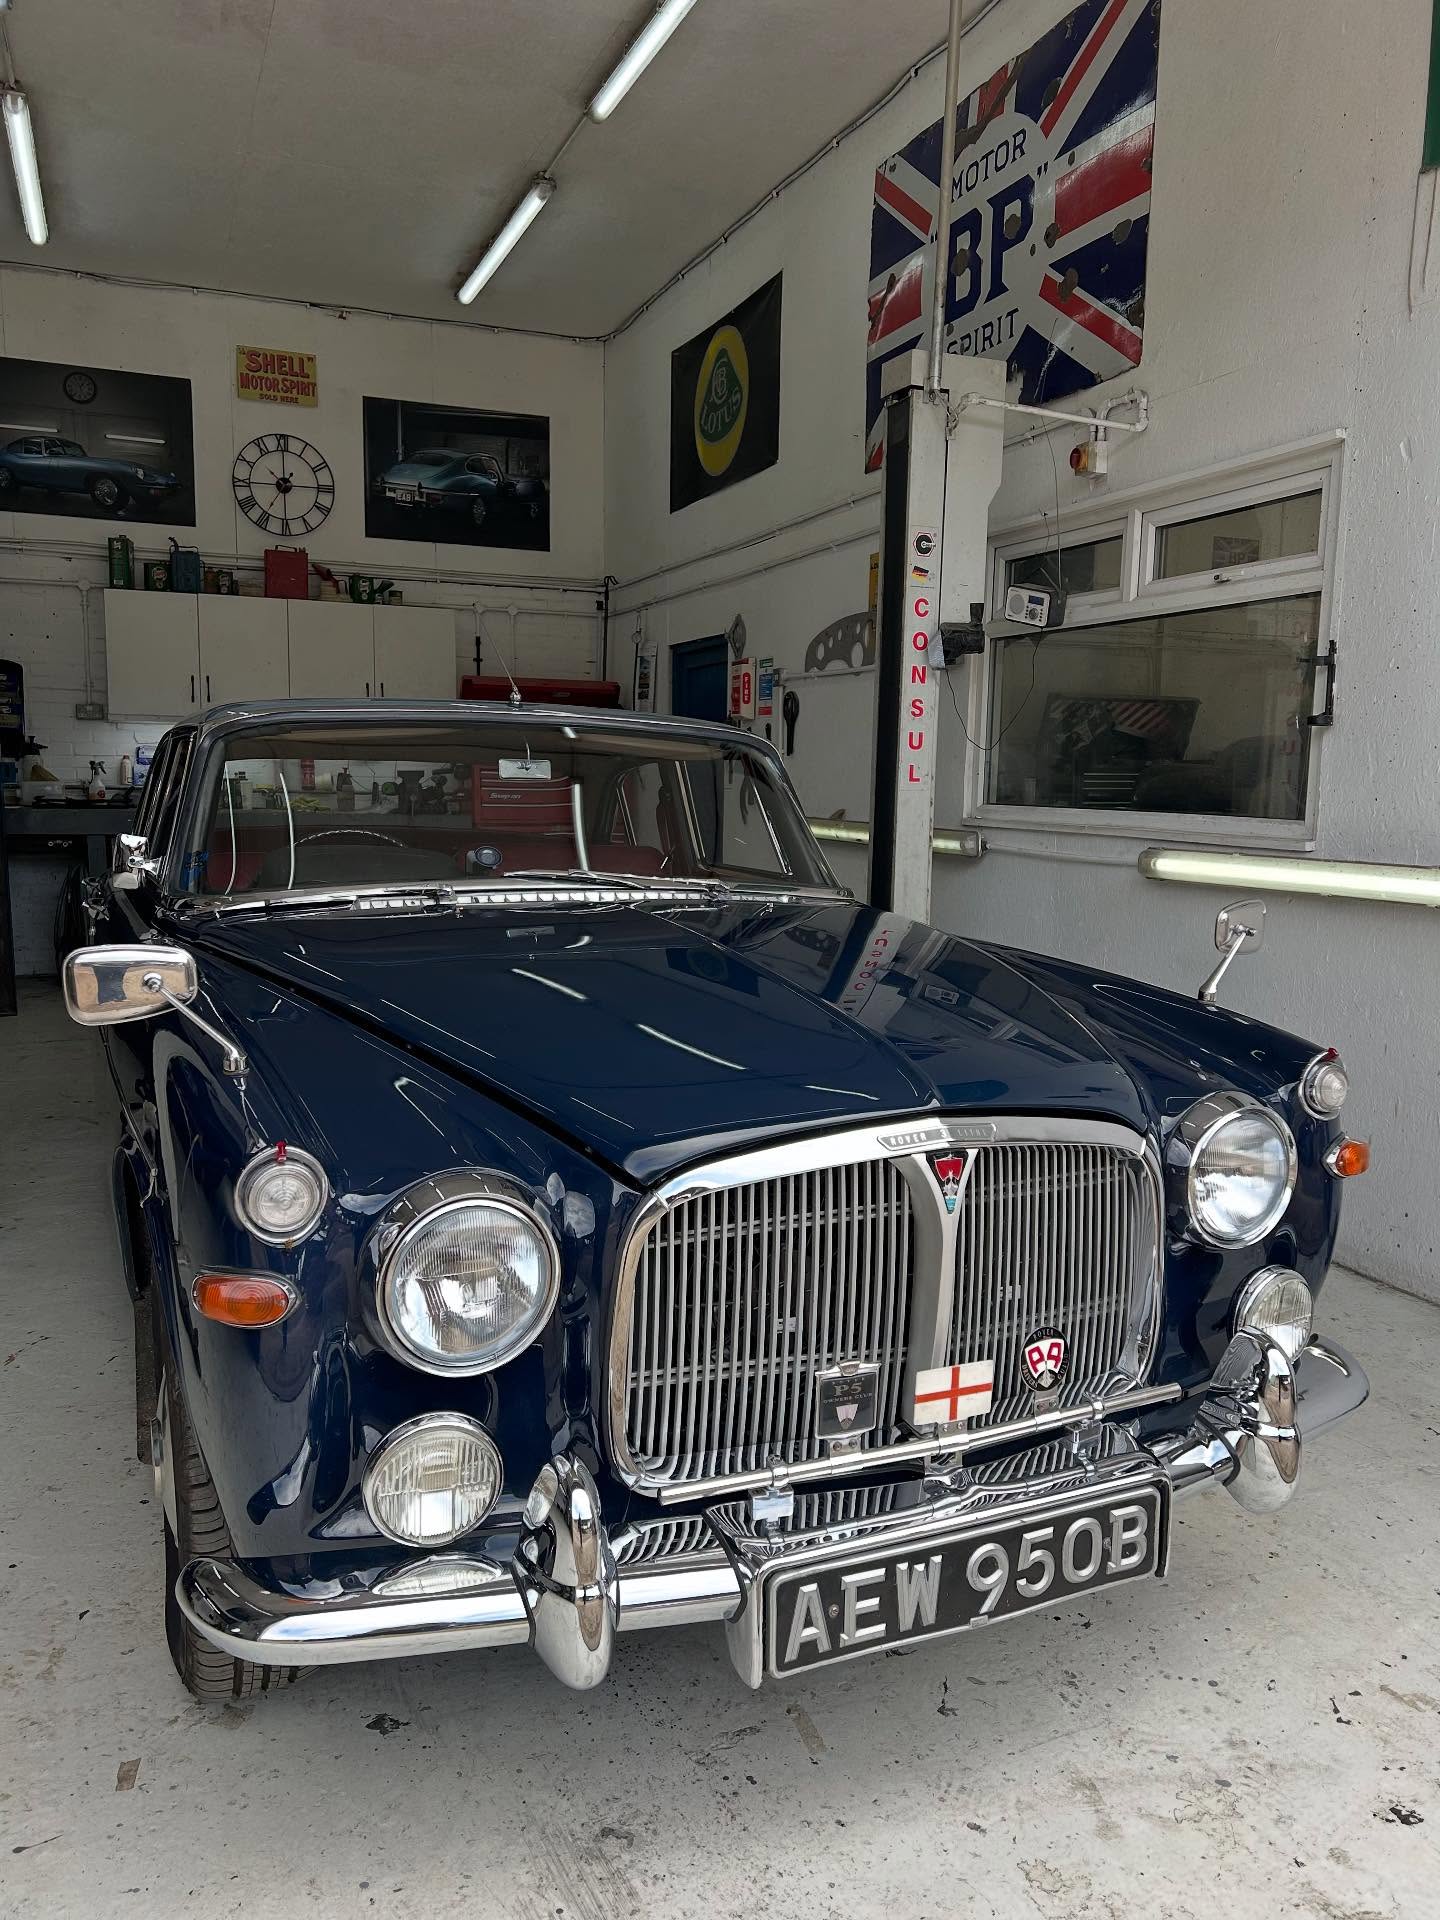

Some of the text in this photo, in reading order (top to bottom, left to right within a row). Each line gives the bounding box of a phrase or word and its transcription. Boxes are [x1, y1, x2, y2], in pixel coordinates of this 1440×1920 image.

[951, 128, 1027, 204] MOTOR
[240, 372, 316, 397] MOTOR SPIRIT
[908, 598, 929, 783] CONSUL
[890, 1132, 927, 1146] ROVER
[834, 1382, 862, 1397] P5
[784, 1504, 1149, 1664] AEW 950B
